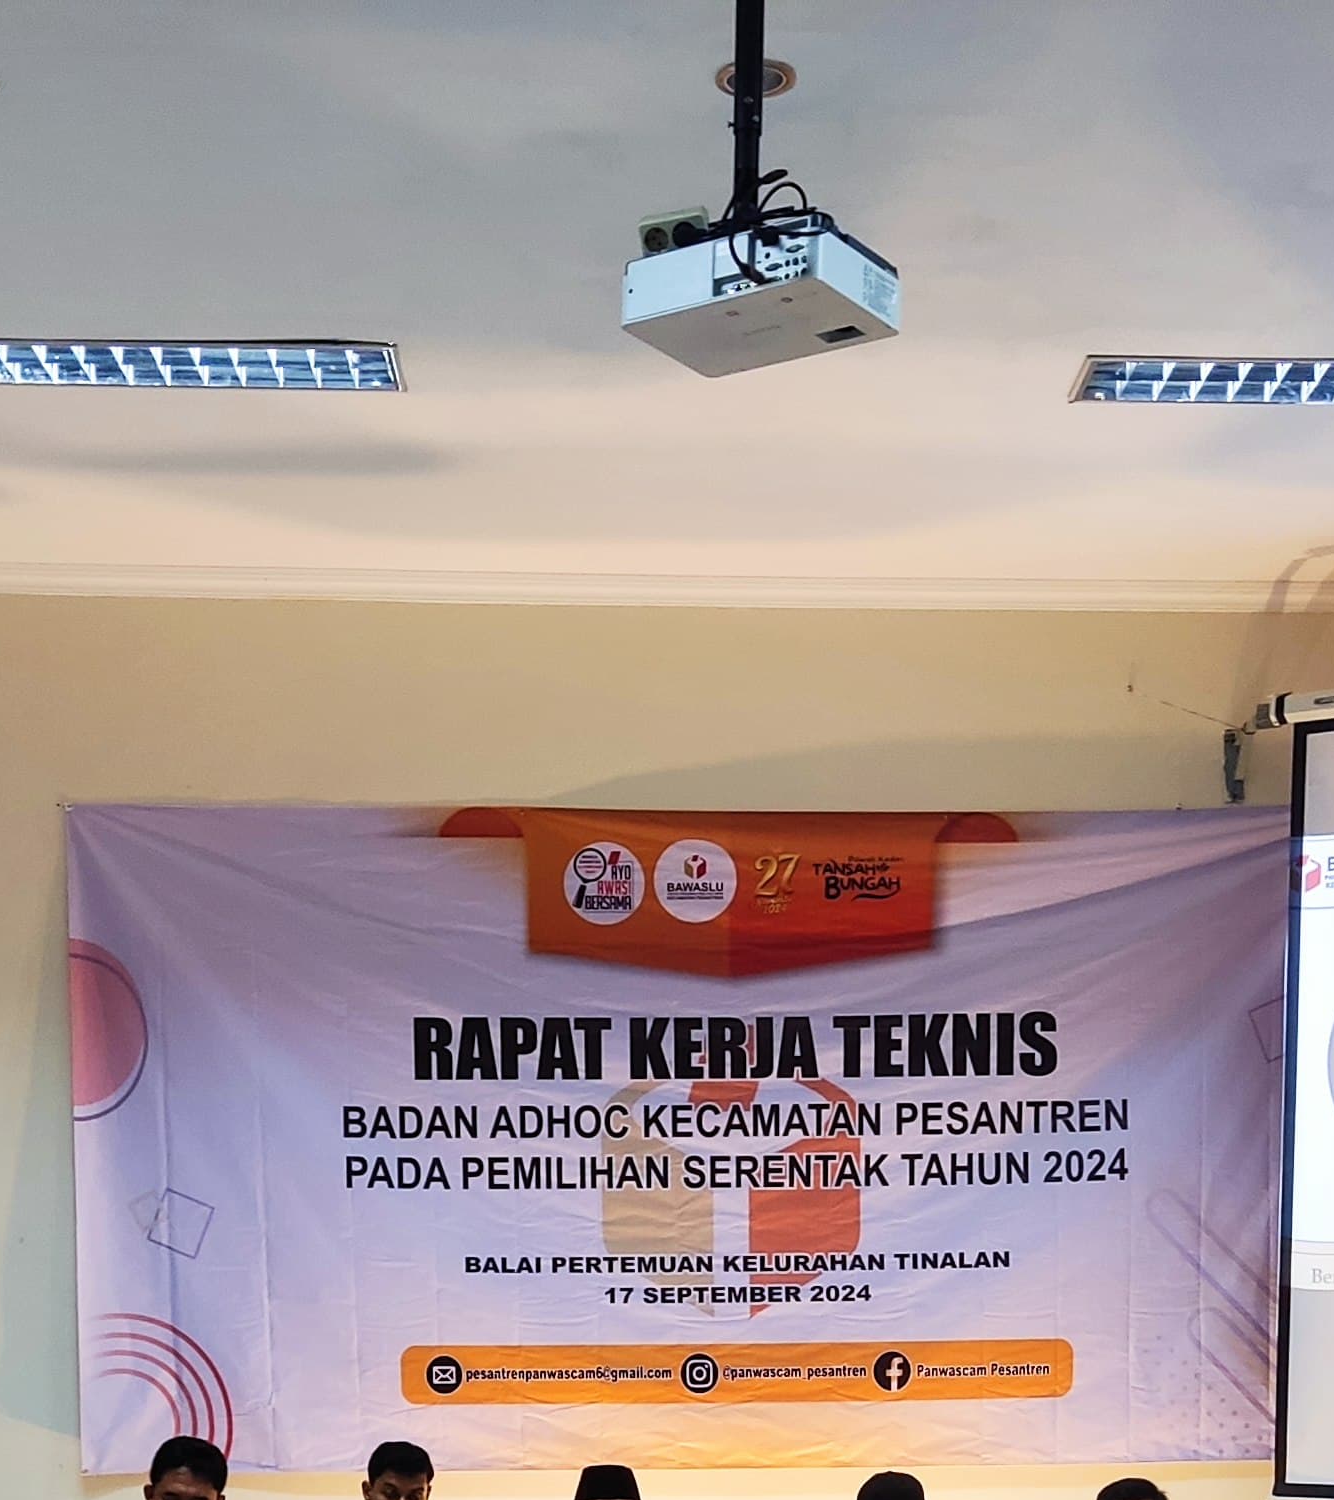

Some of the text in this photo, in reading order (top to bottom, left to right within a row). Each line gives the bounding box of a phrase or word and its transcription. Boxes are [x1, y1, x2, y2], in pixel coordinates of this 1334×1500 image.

[611, 864, 632, 880] AYO
[754, 853, 802, 897] 27
[812, 859, 876, 876] TANSAH
[597, 880, 632, 895] AWASI
[667, 882, 724, 892] BAWASLU
[825, 876, 900, 900] BUNGAH
[584, 895, 632, 910] BERSAMA
[413, 1011, 1058, 1080] RAPAT KERJA TEKNIS
[342, 1099, 1129, 1138] BADAN ADHOC KECAMATAN PESANTREN
[346, 1148, 1129, 1190] PADA PEMILIHAN SERENTAK TAHUN 2024
[465, 1251, 1011, 1273] BALAI PERTEMUAN KELURAHAN TINALAN
[605, 1284, 872, 1304] 17 SEPTEMBER 2024
[723, 1364, 867, 1381] @panwascam_pesantren
[917, 1363, 1050, 1377] Panwascam Pesantren
